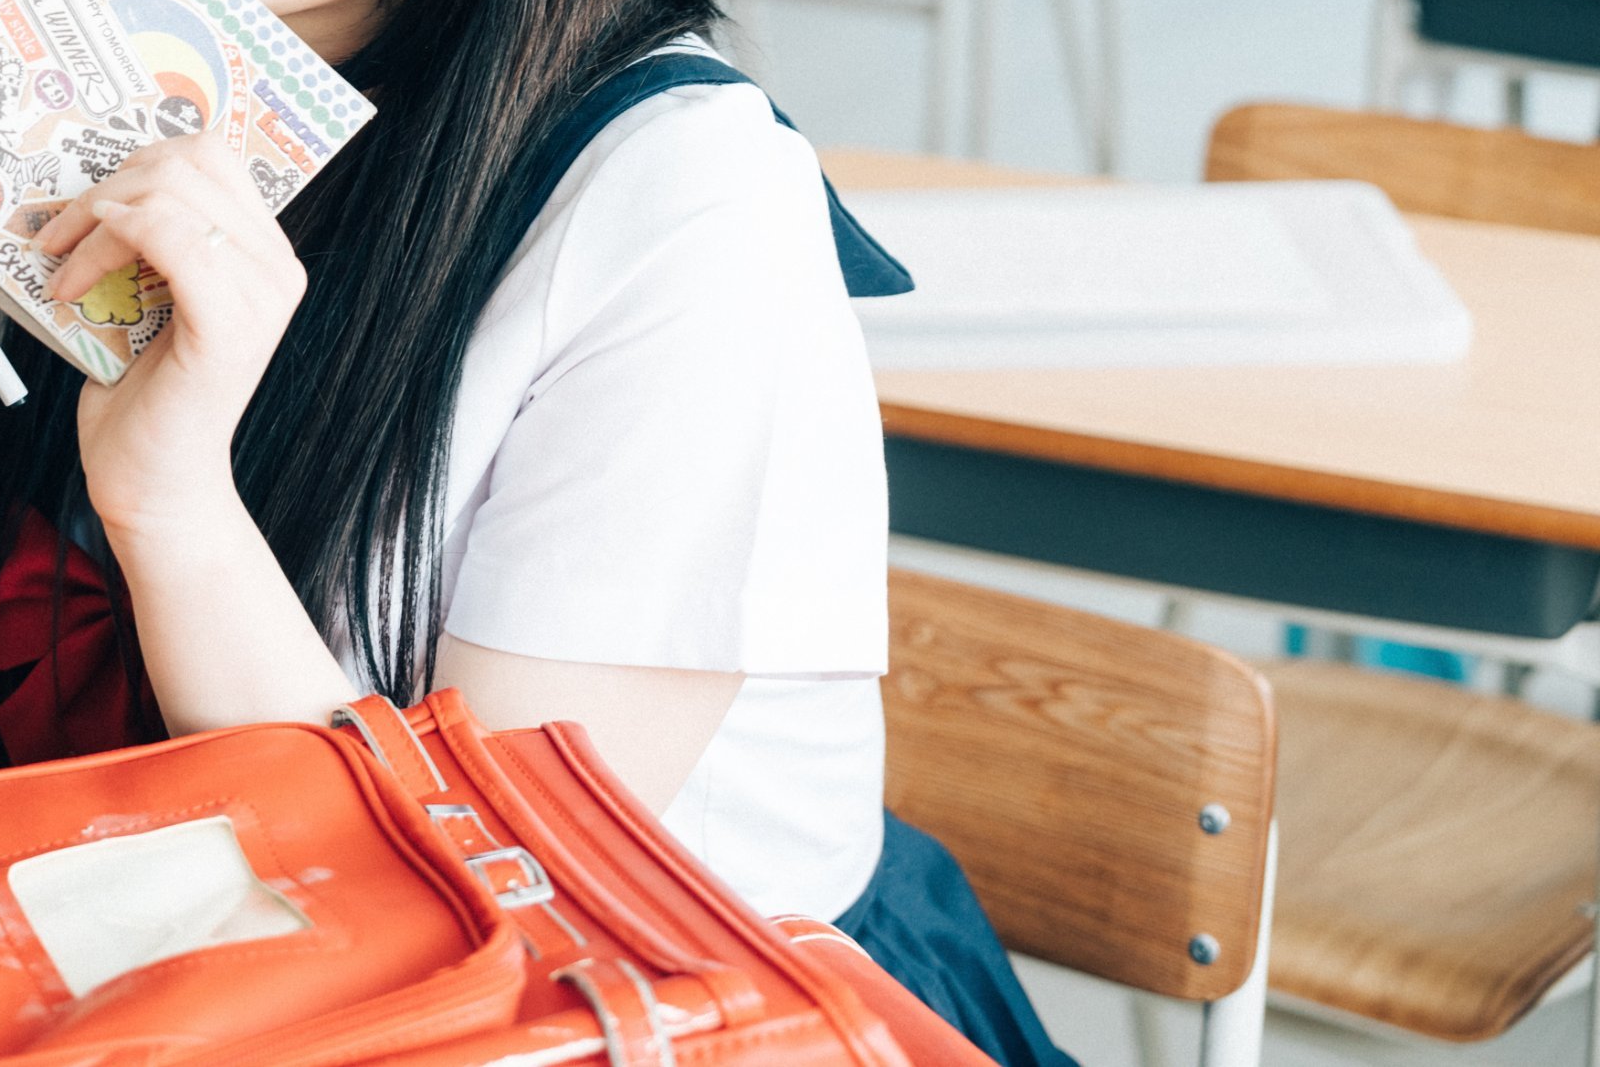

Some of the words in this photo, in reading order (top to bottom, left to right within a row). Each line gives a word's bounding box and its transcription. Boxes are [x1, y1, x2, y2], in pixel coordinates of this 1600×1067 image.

[10, 18, 36, 54] style
[99, 19, 148, 94] TOMORROW
[41, 74, 66, 104] 79
[82, 129, 142, 153] Famil
